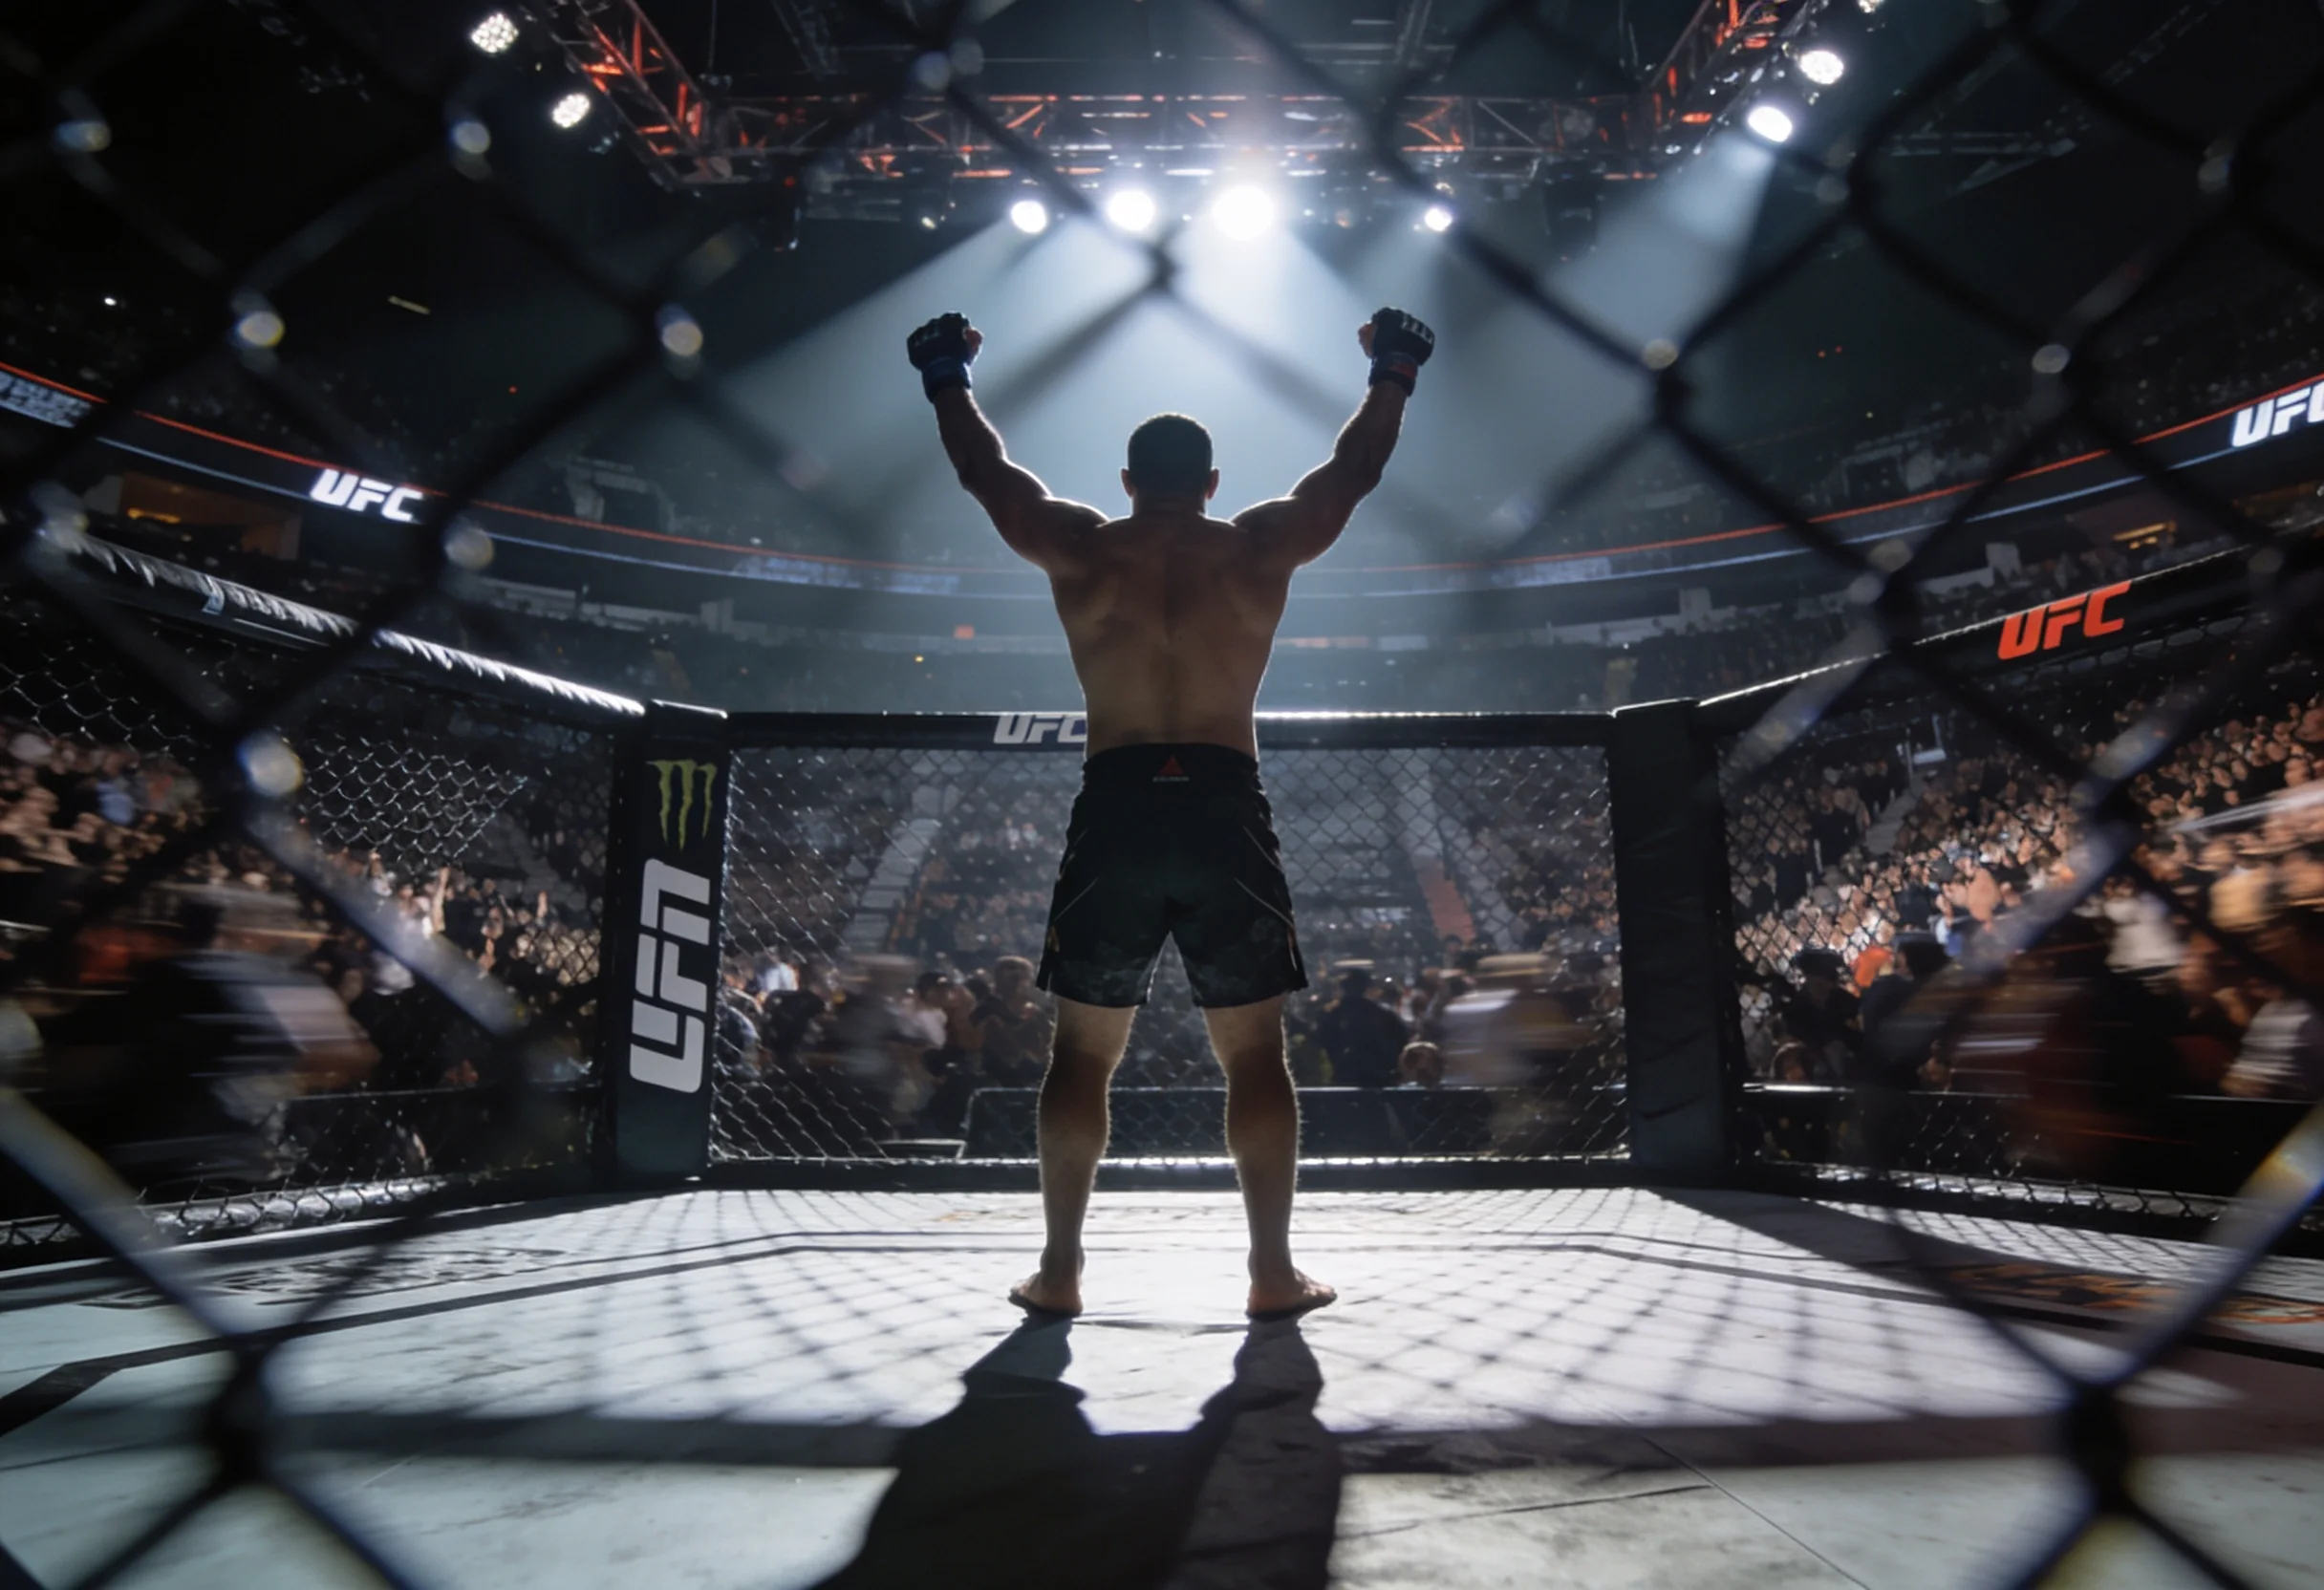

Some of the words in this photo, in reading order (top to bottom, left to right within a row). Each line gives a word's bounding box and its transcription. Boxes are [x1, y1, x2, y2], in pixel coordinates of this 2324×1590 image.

[310, 468, 423, 522] UFC
[1997, 580, 2131, 660] UFC
[993, 712, 1087, 743] UFC
